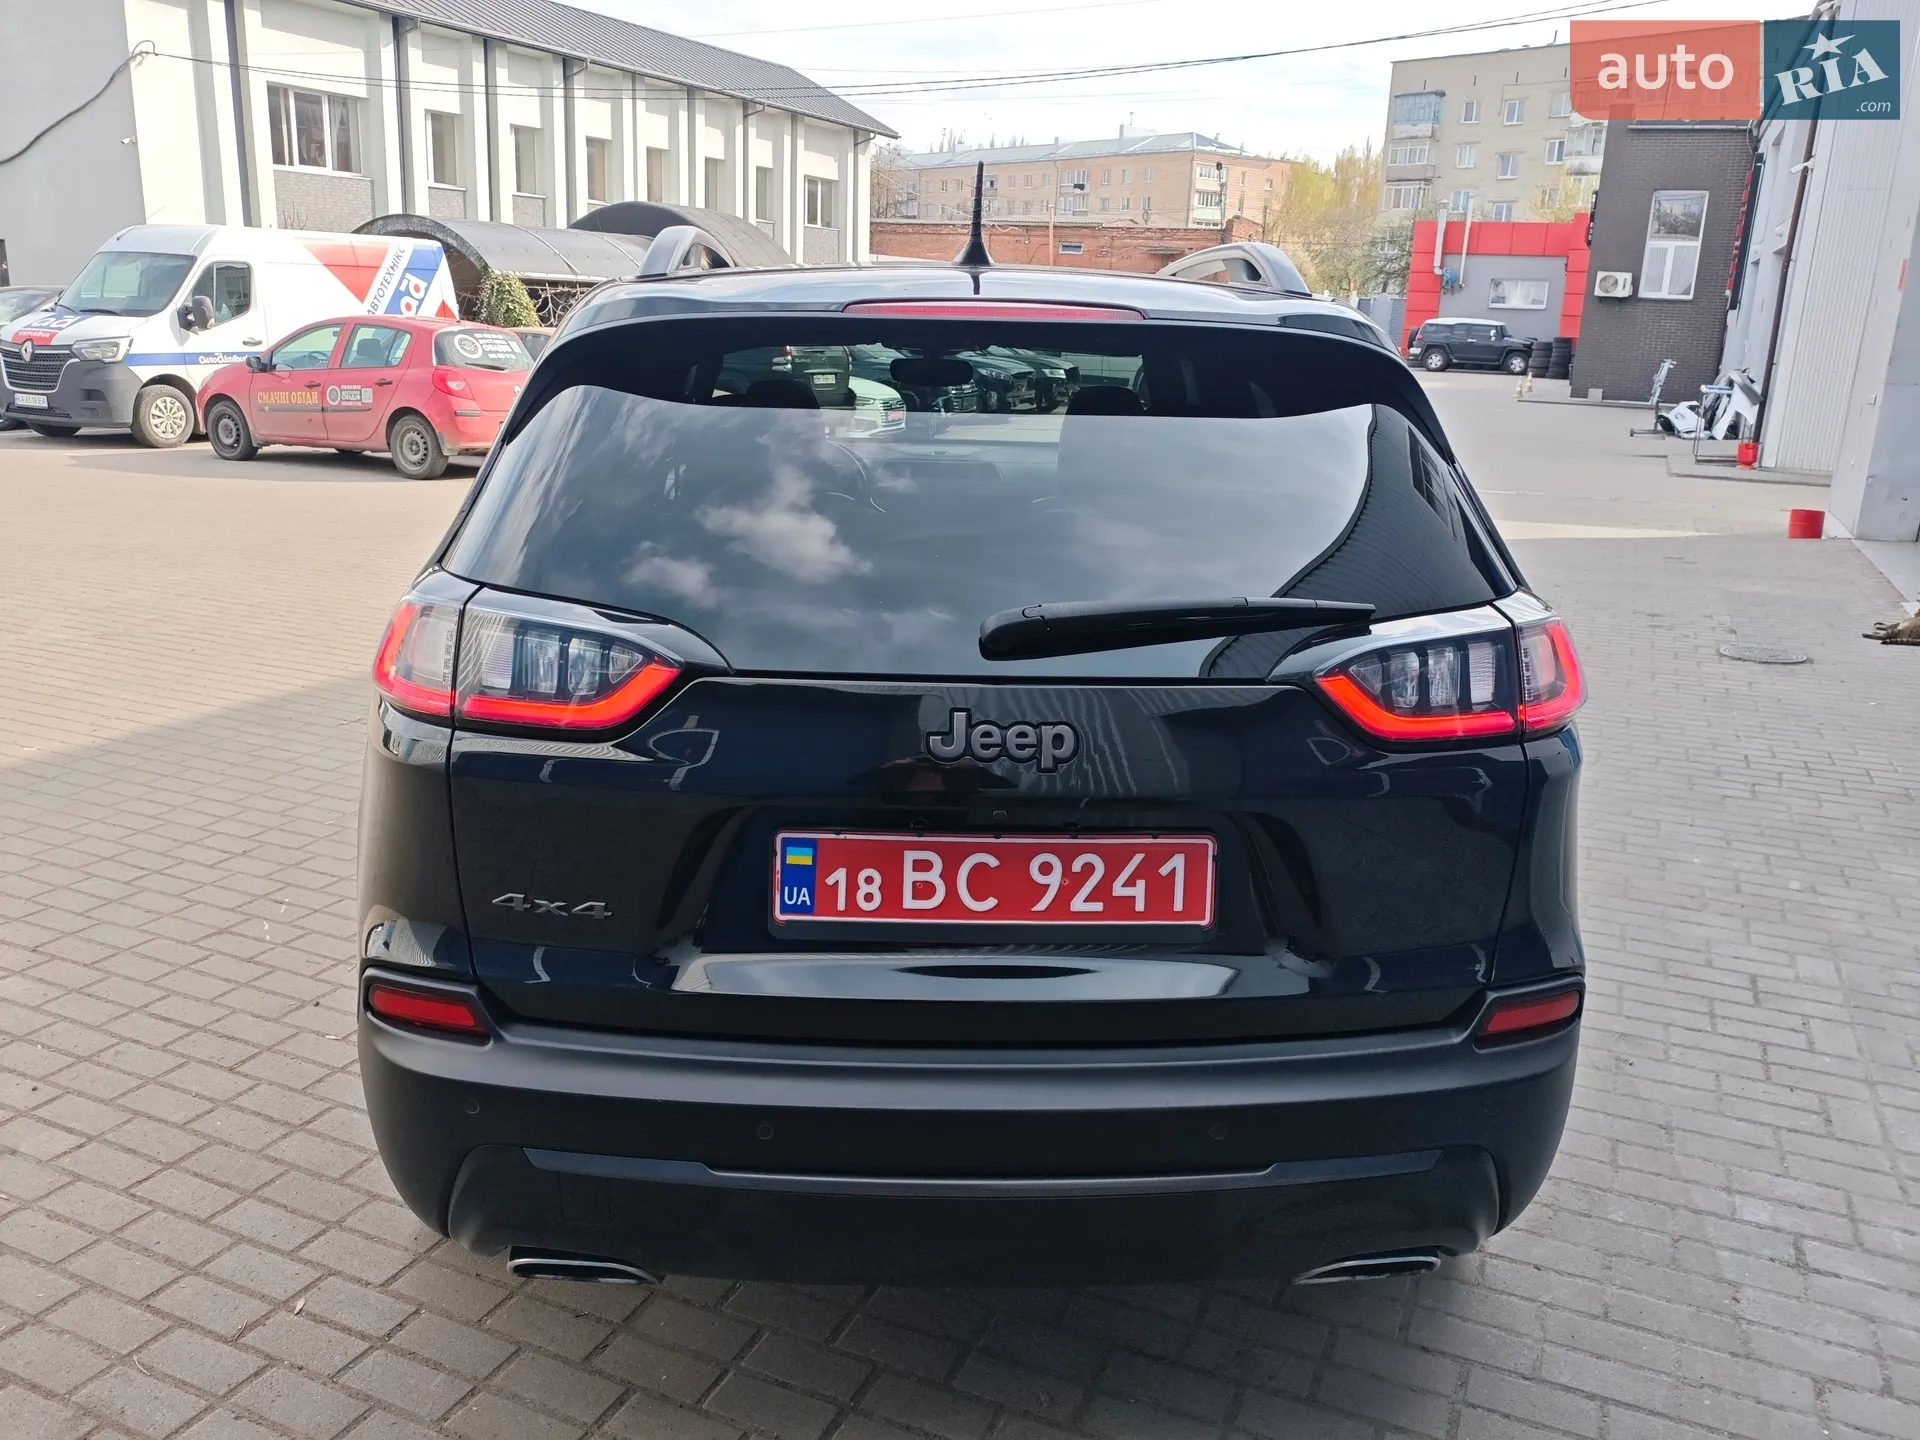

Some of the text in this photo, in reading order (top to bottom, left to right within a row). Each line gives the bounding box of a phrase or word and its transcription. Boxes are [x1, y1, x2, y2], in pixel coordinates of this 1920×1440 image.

[257, 391, 319, 405] СМАЧНІ ОБІДИ
[929, 710, 1077, 770] Jeep
[825, 850, 1186, 912] 18 BC 9241
[491, 892, 613, 919] 4x4
[783, 886, 811, 905] UA
